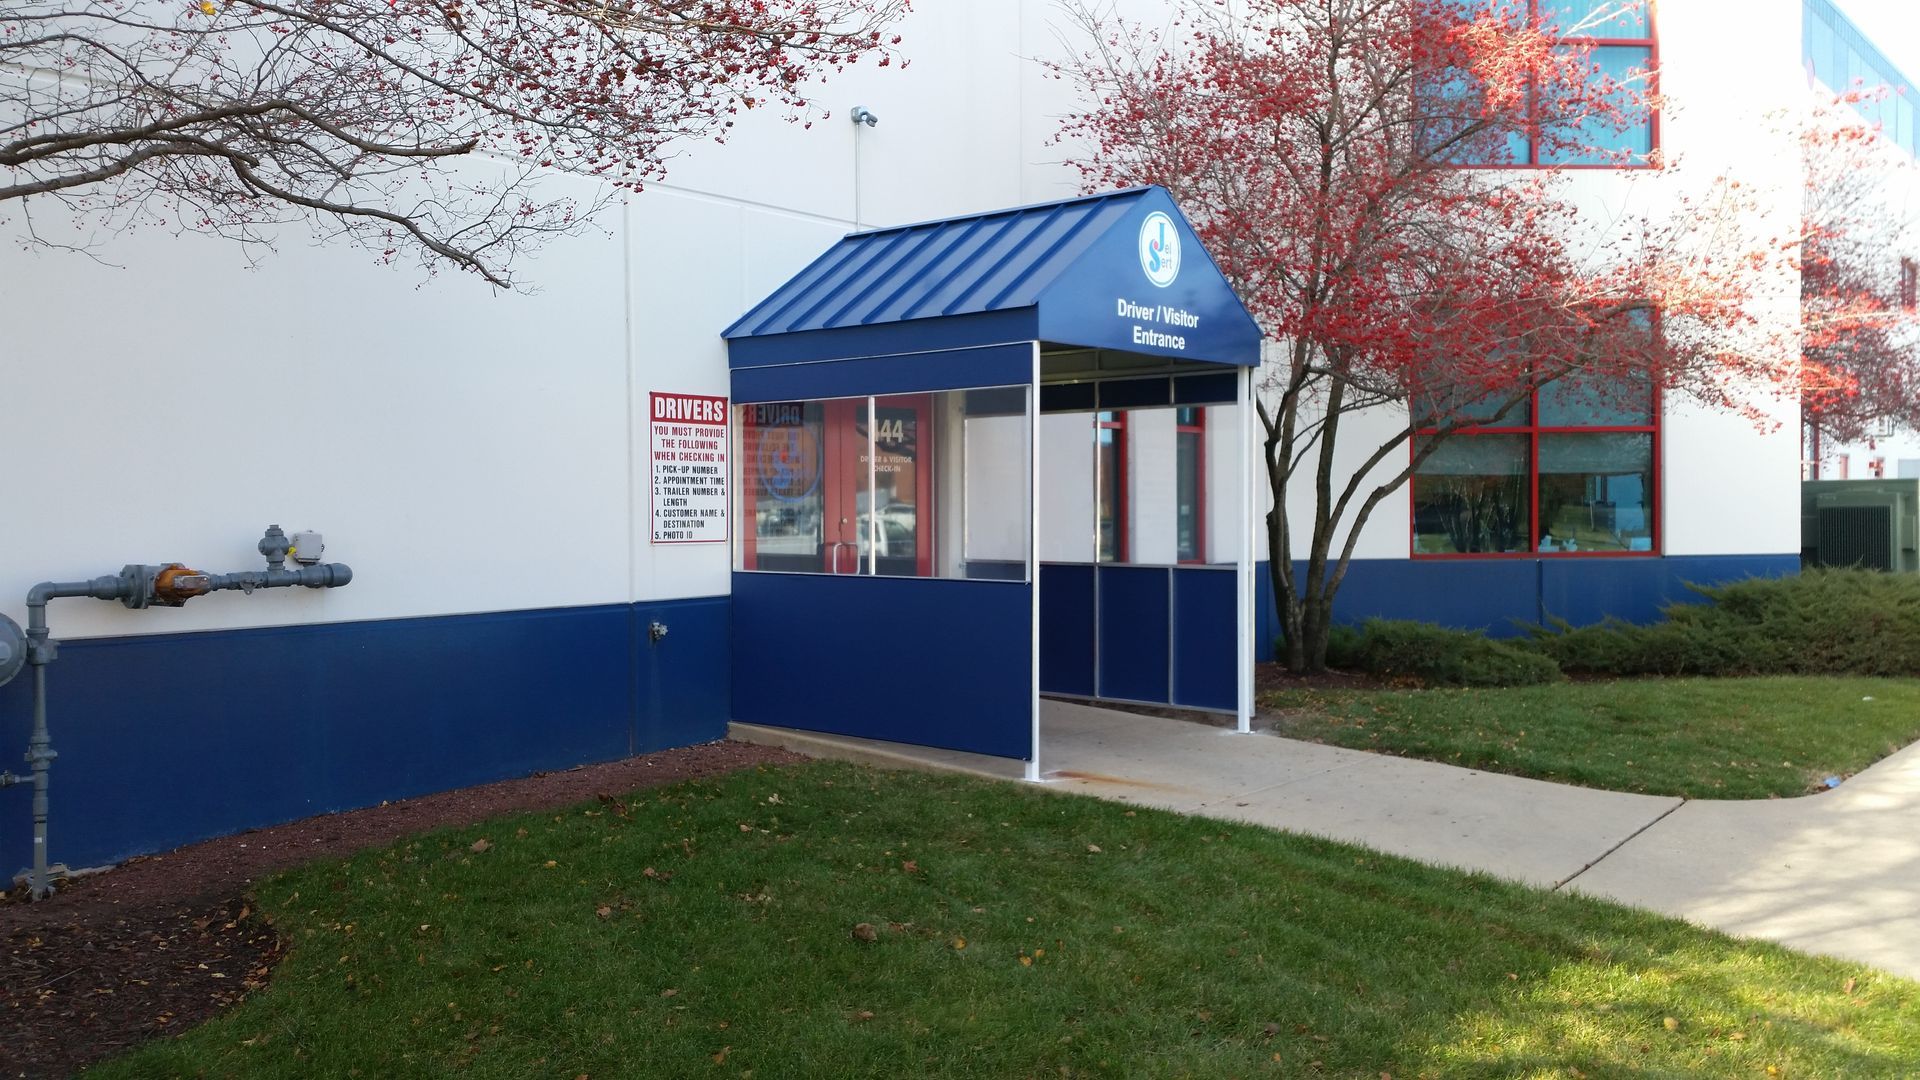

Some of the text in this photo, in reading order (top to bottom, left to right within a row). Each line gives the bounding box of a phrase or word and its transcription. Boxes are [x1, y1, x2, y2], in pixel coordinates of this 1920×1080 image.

[1117, 298, 1199, 328] Driver / Visitor
[1133, 325, 1185, 350] Entrance
[655, 397, 723, 422] DRIVERS
[654, 426, 724, 438] YOU MUST PROVIDE
[661, 439, 718, 450] THE FOLLOWING
[654, 451, 724, 462] WHEN CHECKING IN
[656, 465, 718, 474] 1. PICK-UP NUMBER
[654, 476, 724, 486] 2. APPOINTMENT TIME
[654, 487, 725, 496] 3. TRAILER NUMBER &
[664, 498, 688, 506] LENGTH
[655, 509, 725, 518] 4. CUSTOMER NAME &
[664, 520, 704, 528] DESTINATION
[654, 531, 693, 540] 5. PHOTO ID
